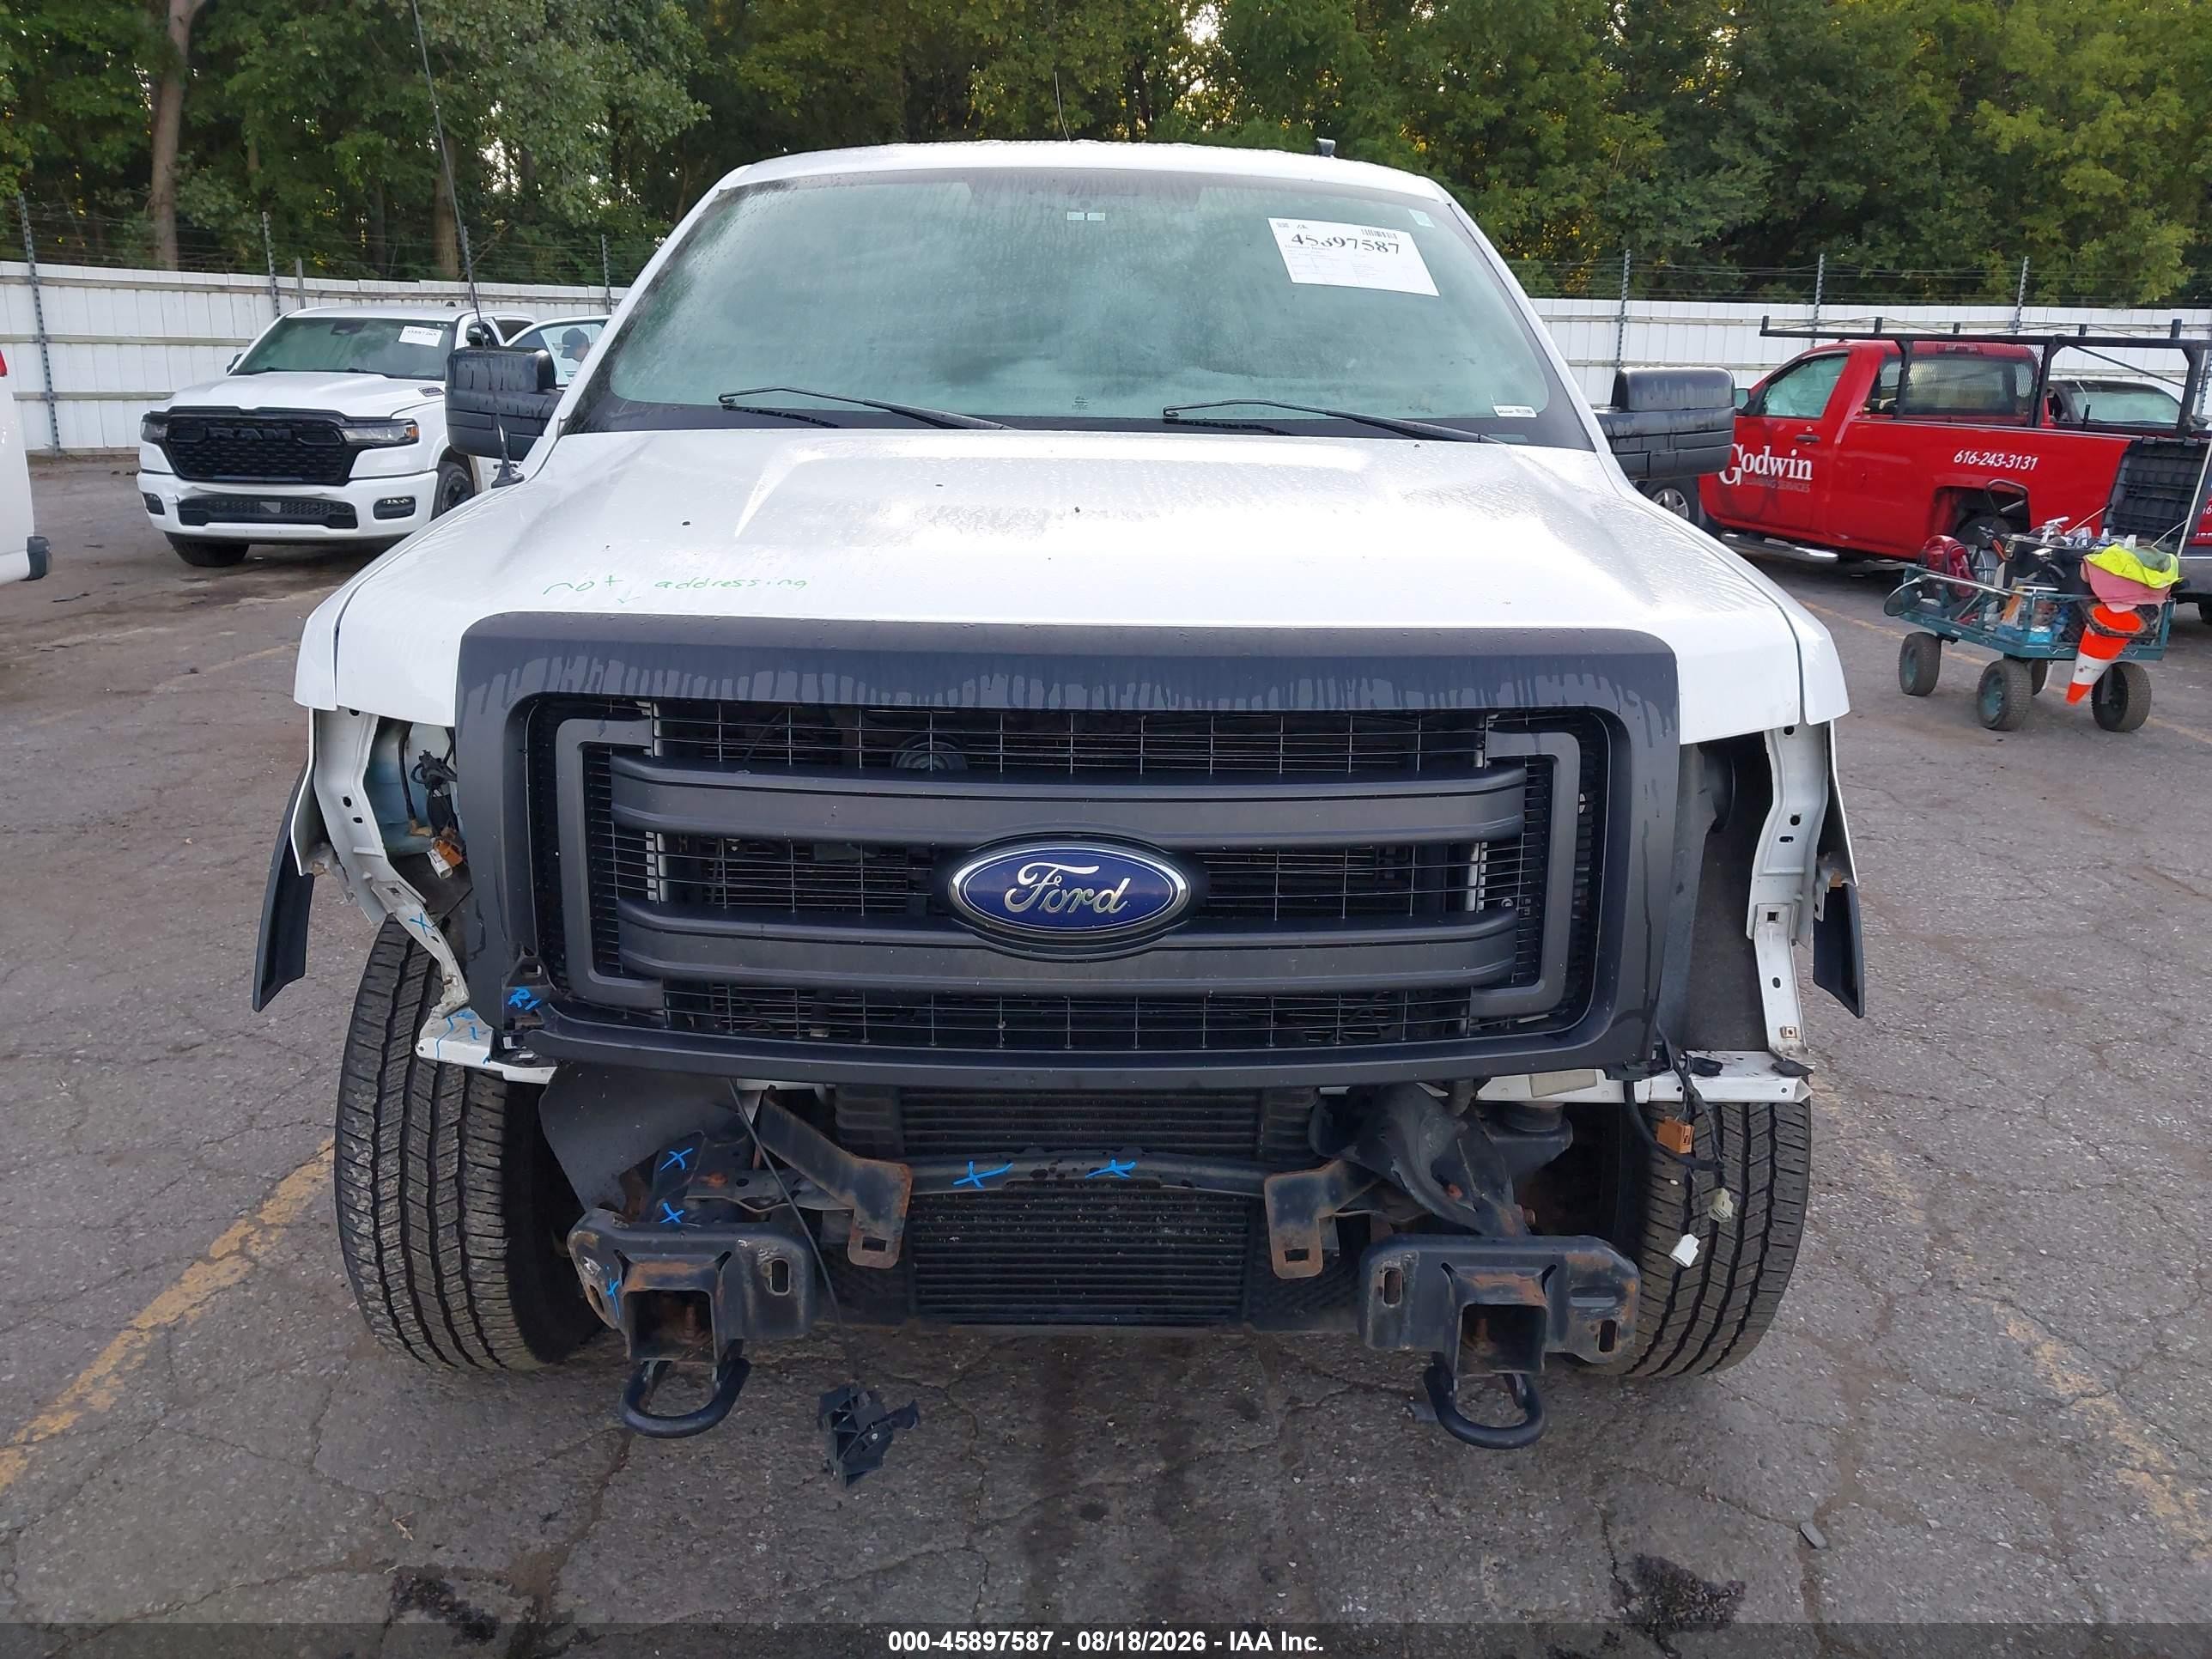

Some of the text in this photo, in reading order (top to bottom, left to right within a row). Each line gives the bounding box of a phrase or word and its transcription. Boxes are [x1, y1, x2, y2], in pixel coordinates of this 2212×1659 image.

[206, 427, 292, 441] RAM
[1718, 443, 1813, 486] Godwin
[1954, 450, 2039, 471] 616-243-3131
[543, 575, 808, 595] not addressing
[1004, 862, 1132, 914] Ford
